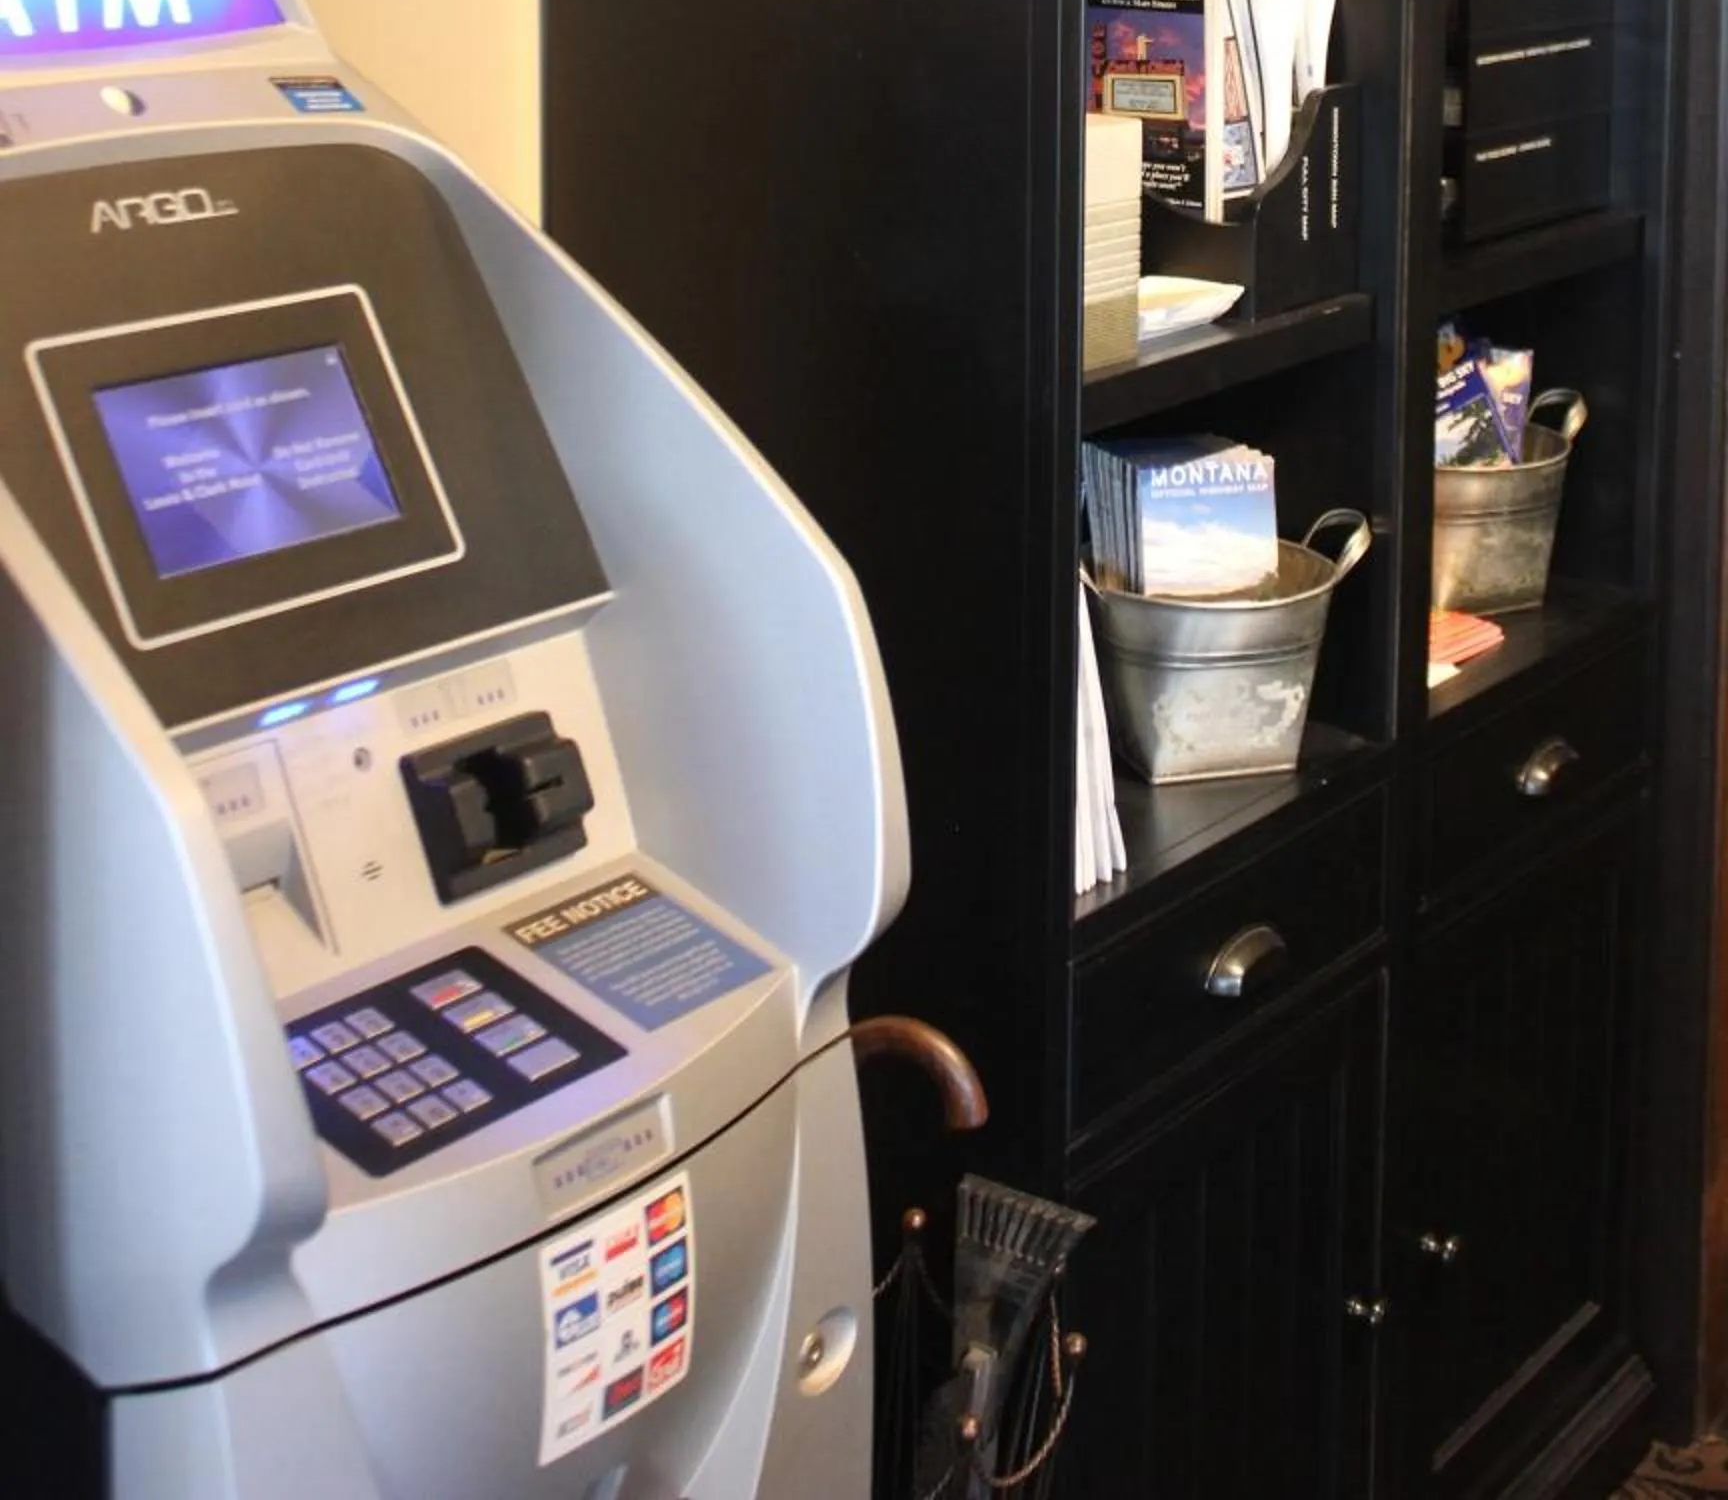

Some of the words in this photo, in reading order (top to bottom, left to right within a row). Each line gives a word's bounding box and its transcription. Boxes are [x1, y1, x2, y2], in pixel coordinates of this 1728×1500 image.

[90, 188, 214, 234] ARGO
[1150, 460, 1268, 488] MONTANA
[514, 914, 571, 944] FEE
[559, 880, 649, 925] NOTICE
